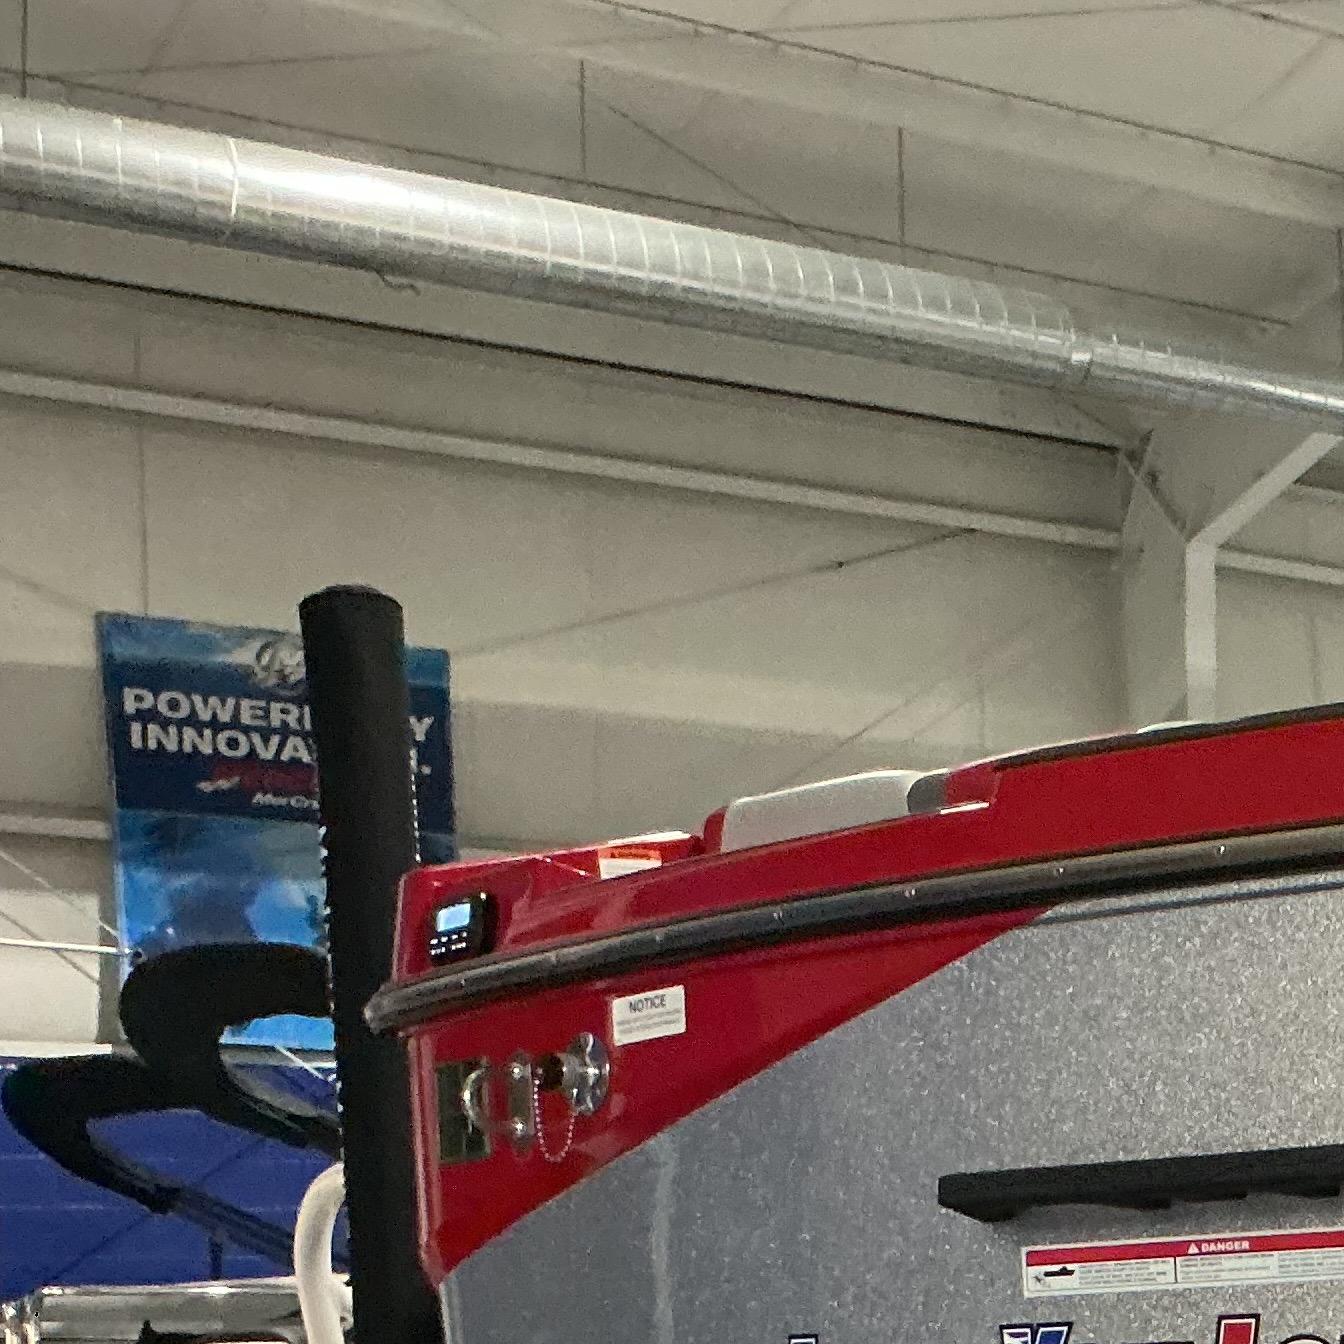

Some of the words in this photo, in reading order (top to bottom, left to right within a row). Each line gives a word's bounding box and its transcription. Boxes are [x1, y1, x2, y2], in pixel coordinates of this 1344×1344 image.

[121, 686, 312, 732] POWER
[628, 993, 667, 1013] NOTICE
[1201, 1239, 1251, 1254] DANGER
